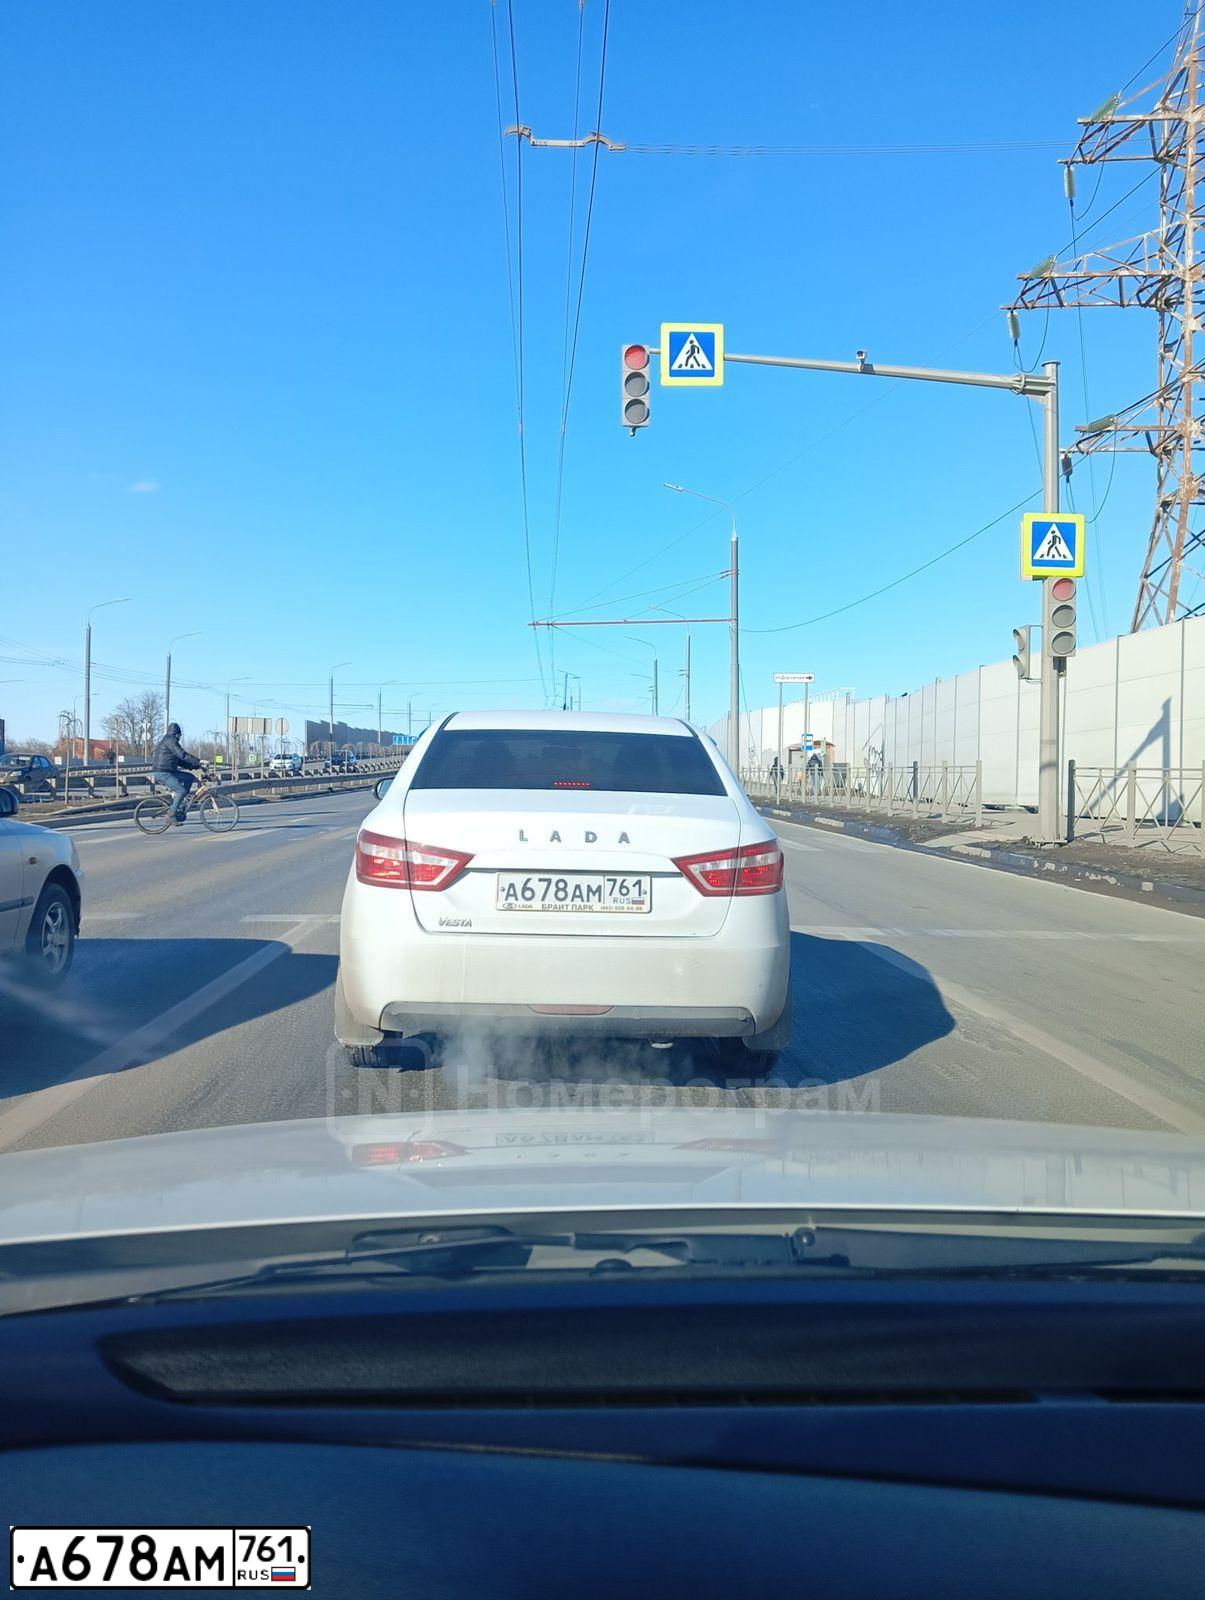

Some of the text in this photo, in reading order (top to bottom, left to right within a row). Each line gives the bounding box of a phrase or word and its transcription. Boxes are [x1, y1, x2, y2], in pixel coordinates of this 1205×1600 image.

[518, 829, 630, 843] LADA
[505, 878, 643, 903] А678АМ 761
[613, 897, 631, 905] RUS
[439, 917, 473, 929] VESTA
